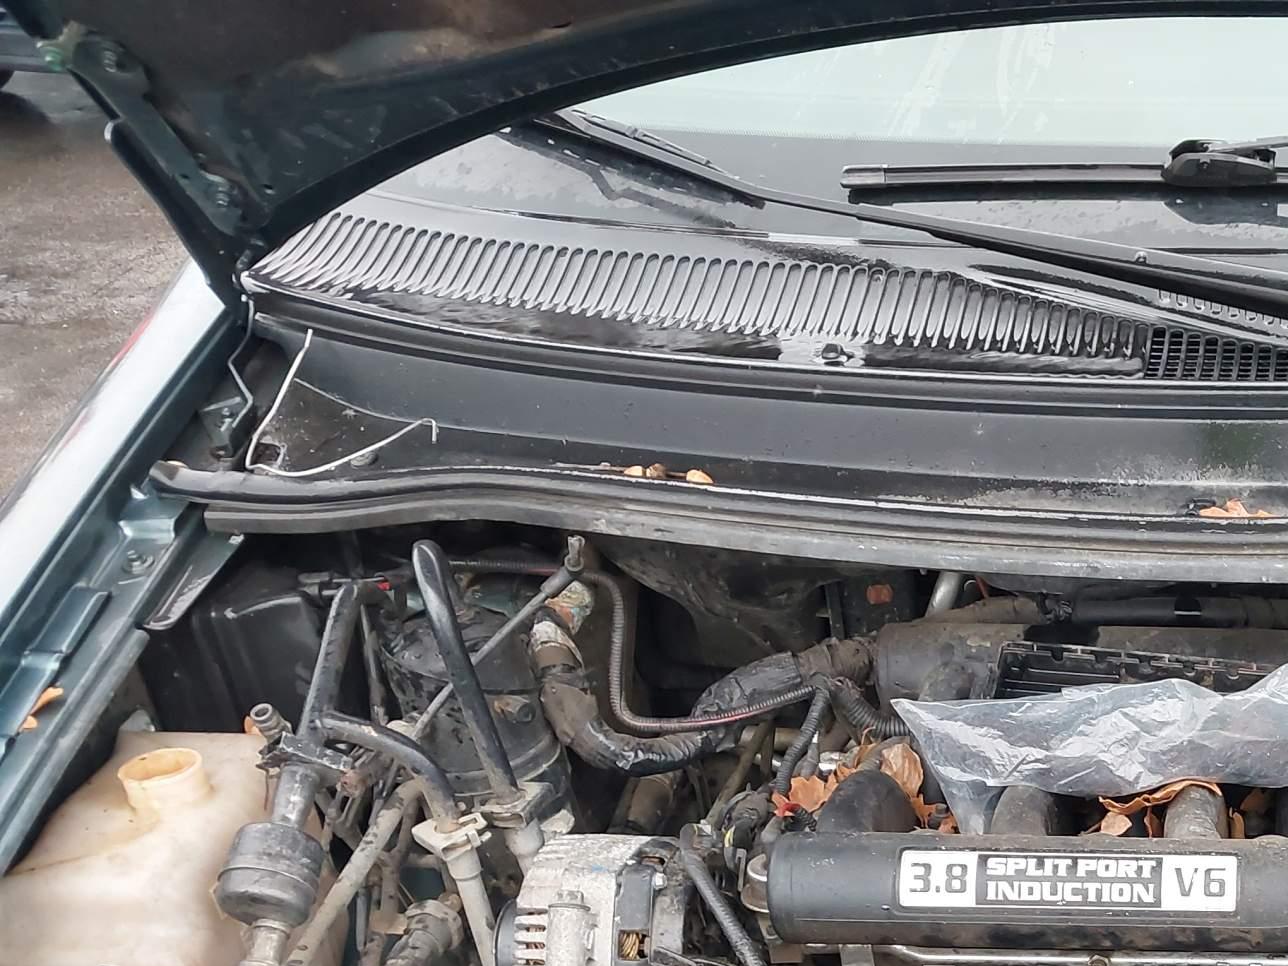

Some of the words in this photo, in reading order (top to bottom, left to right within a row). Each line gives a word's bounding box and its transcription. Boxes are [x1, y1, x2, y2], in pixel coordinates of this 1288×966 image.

[909, 863, 968, 894] 3.8
[985, 857, 1073, 878] SPLIT
[1076, 859, 1157, 879] PORT
[985, 880, 1155, 904] INDUCTION
[1174, 867, 1227, 897] V6
